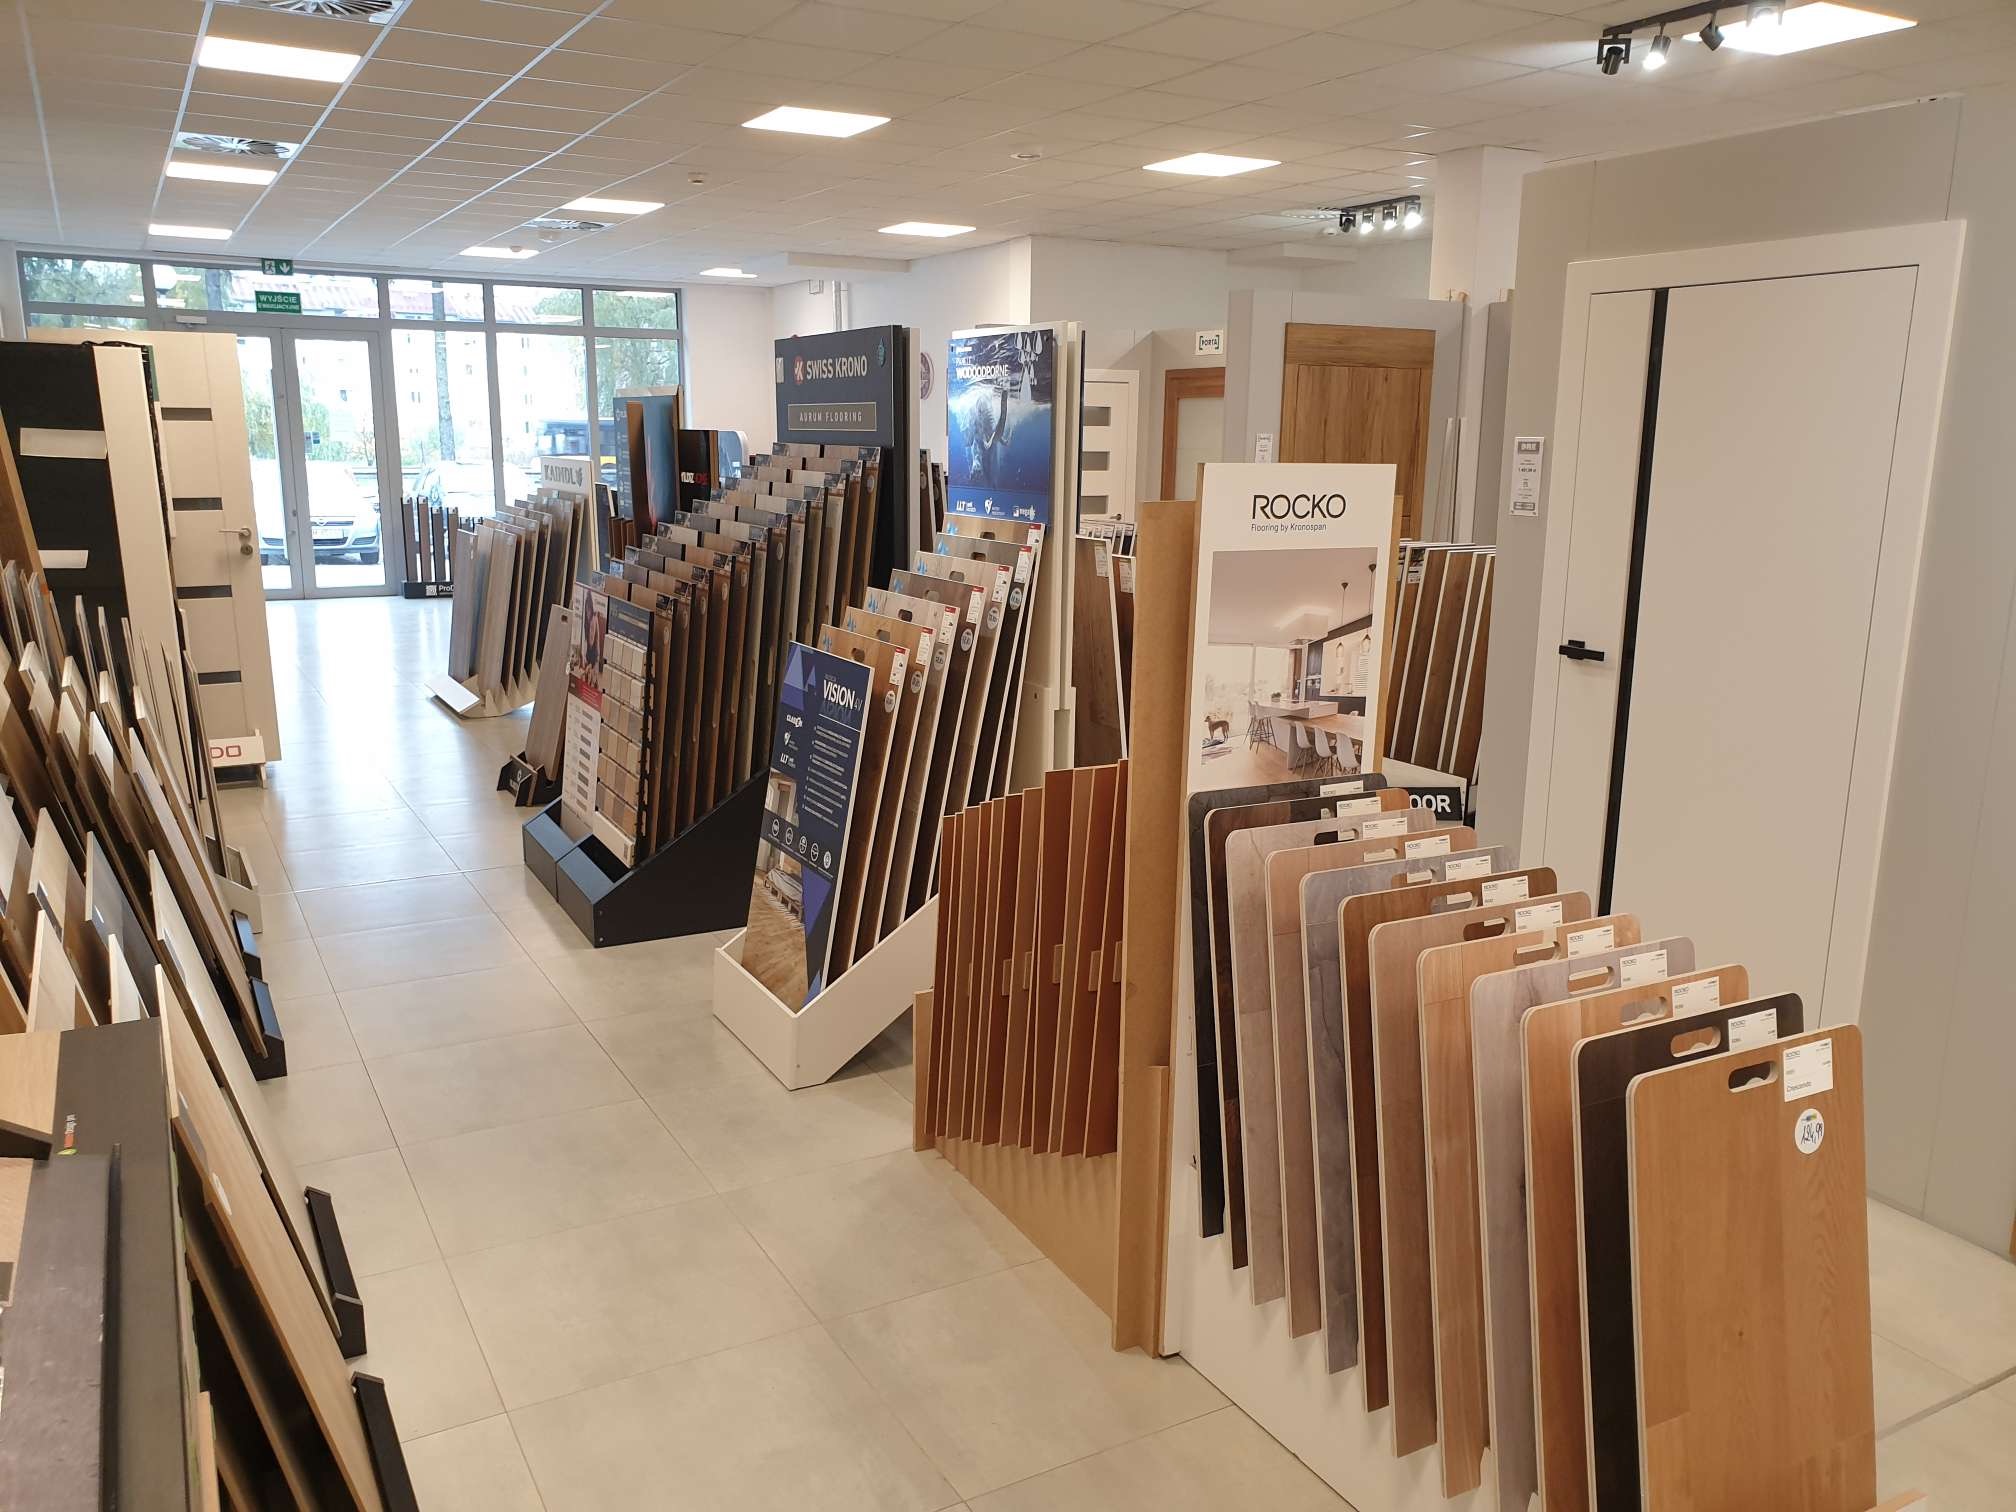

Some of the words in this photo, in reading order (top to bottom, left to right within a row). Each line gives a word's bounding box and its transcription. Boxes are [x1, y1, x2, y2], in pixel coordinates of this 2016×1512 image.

[259, 294, 297, 302] WYJŚCIE
[806, 358, 833, 380] SWISS
[835, 355, 868, 378] KRONO
[956, 365, 1008, 378] WODOODPORNE
[799, 411, 822, 422] AURUM
[825, 411, 862, 422] FLOORING
[1252, 493, 1346, 519] ROCKO
[1251, 523, 1279, 534] Flooring
[1280, 523, 1289, 533] by
[1290, 522, 1327, 532] Kronospan
[823, 680, 856, 710] VISION
